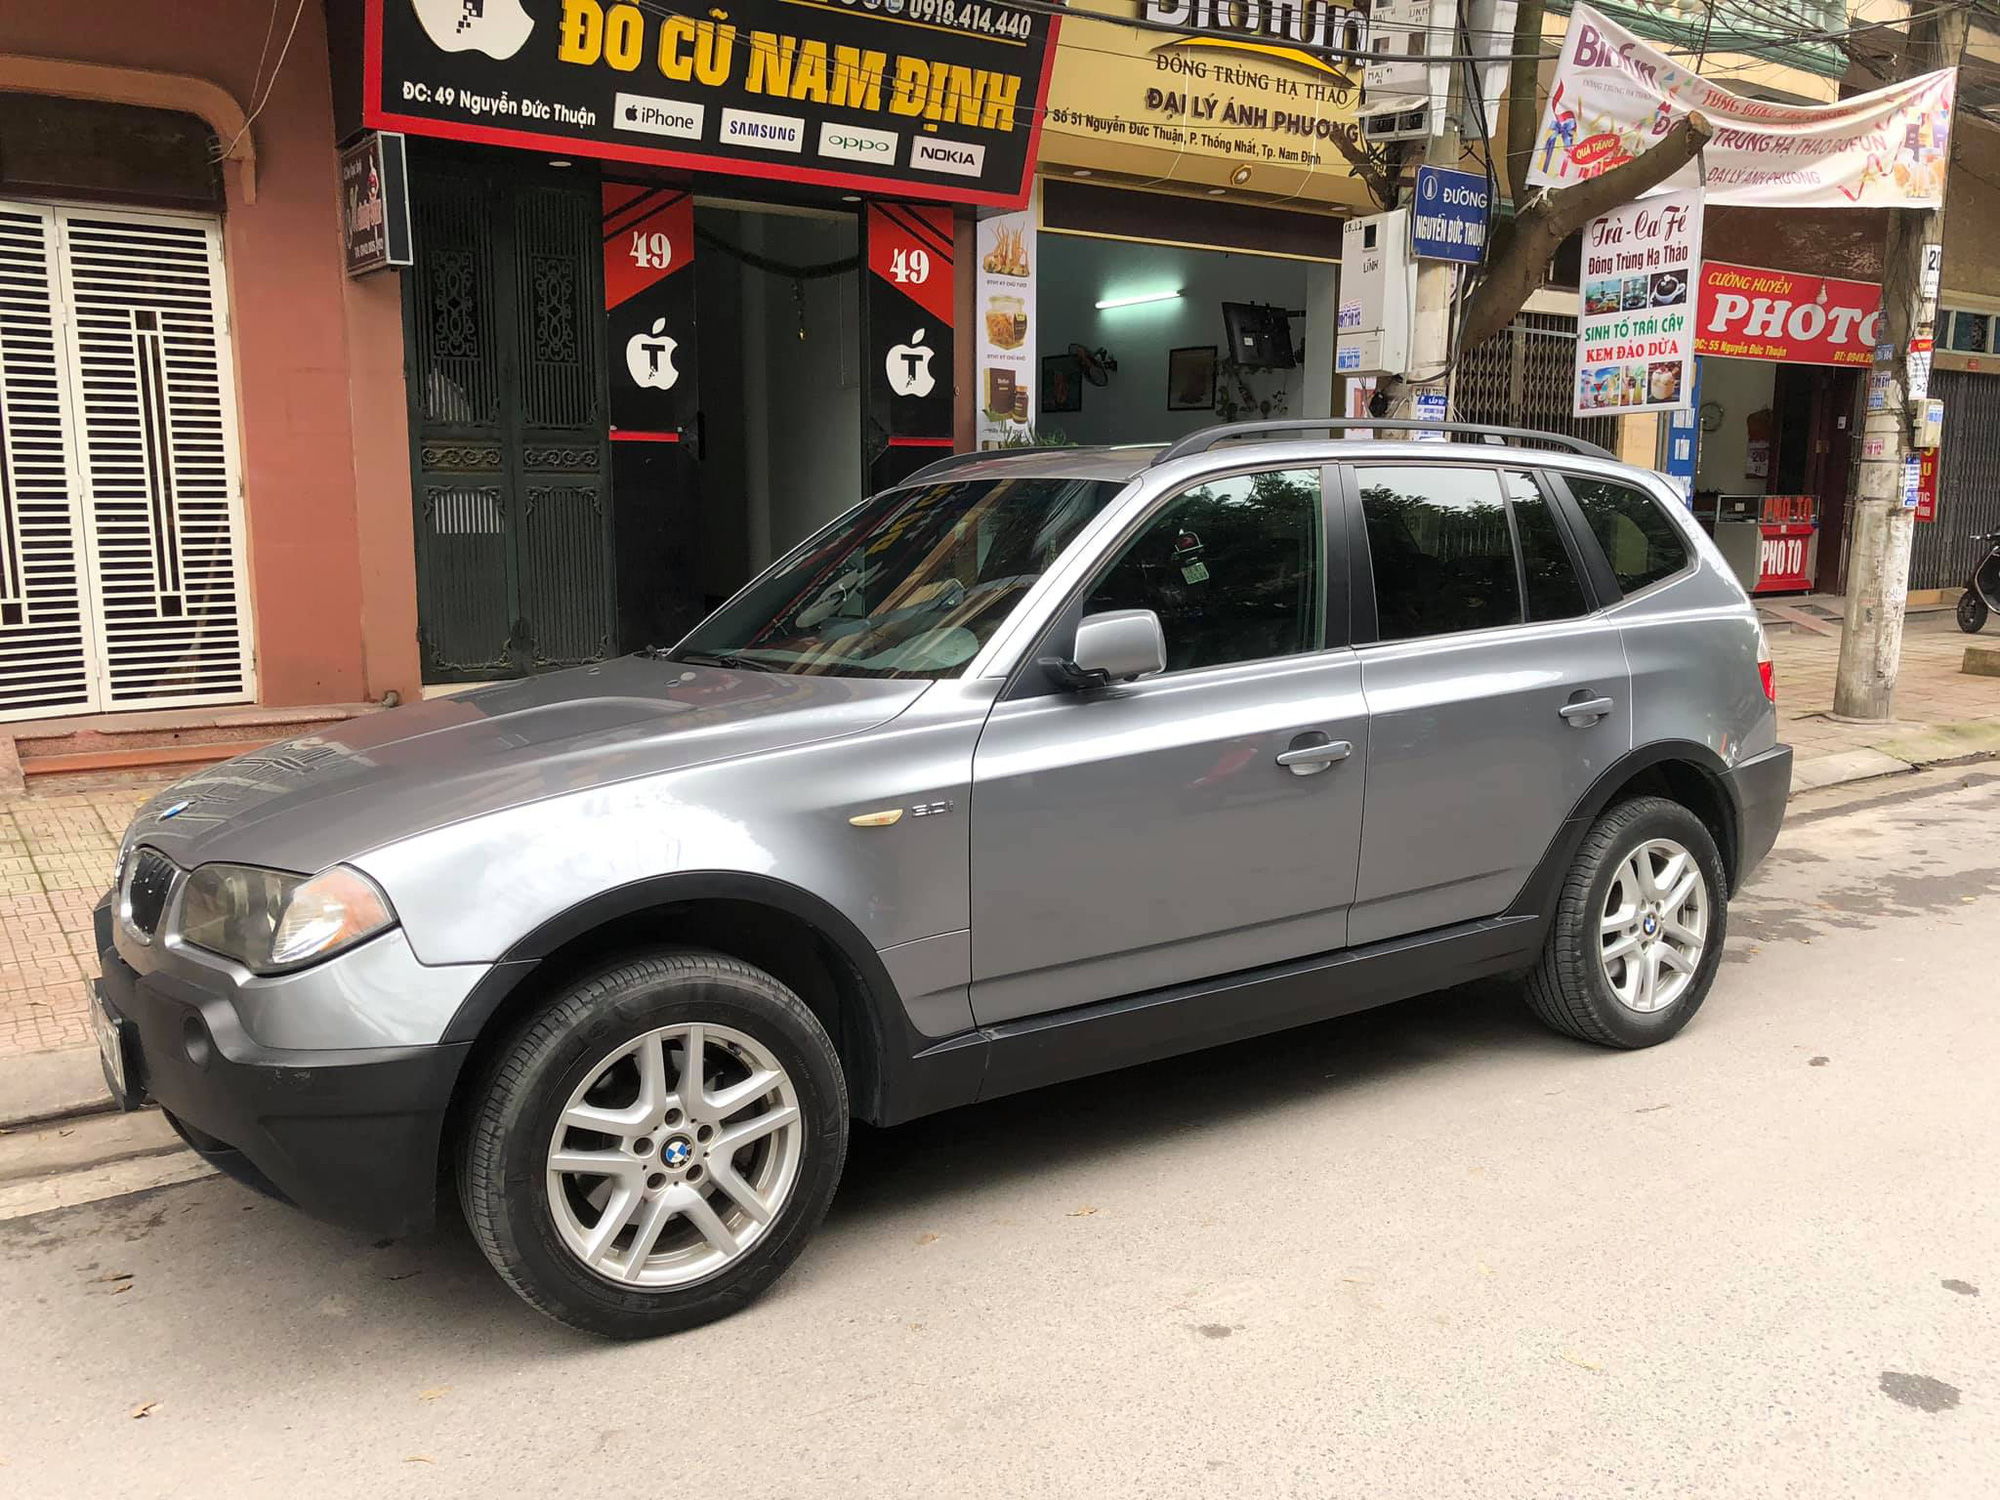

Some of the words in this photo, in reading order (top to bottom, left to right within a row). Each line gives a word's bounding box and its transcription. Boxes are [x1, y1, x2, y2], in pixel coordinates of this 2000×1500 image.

[909, 0, 1032, 39] 0918.414.440
[658, 7, 737, 87] CŨ
[745, 30, 887, 112] NAM
[889, 55, 1022, 132] ĐỊNH
[1156, 53, 1207, 79] ĐÔNG
[1213, 63, 1270, 91] TRÙNG
[1276, 78, 1299, 100] HẠ
[402, 80, 432, 103] ĐC:
[434, 86, 455, 106] 49
[459, 89, 518, 116] Nguyễn
[521, 98, 551, 120] Đức
[553, 103, 596, 129] Thuận
[641, 106, 694, 130] iPhone
[1145, 87, 1187, 120] ĐẠI
[1190, 92, 1219, 121] LÝ
[1221, 96, 1267, 129] ÁNH
[729, 119, 796, 142] SAMSUNG
[1052, 107, 1070, 124] Số
[1071, 111, 1082, 126] 51
[1085, 114, 1125, 134] Nguyễn
[1189, 133, 1198, 146] P.
[1201, 133, 1232, 154] Thống
[1262, 144, 1275, 160] Tp.
[1278, 147, 1299, 162] Nam
[1301, 151, 1322, 166] Định
[920, 146, 976, 166] NOKIA
[1443, 186, 1488, 209] ĐƯỜNG
[1415, 213, 1446, 242] NGUYỄN
[1447, 215, 1464, 244] ĐỨC
[628, 231, 672, 270] 49
[889, 247, 930, 285] 49
[1588, 256, 1613, 275] Đông
[1647, 247, 1660, 269] Hạ
[1663, 241, 1689, 264] Thảo
[1707, 271, 1752, 290] CƯỜNG
[1584, 325, 1610, 342] SINH
[1613, 316, 1631, 339] TỐ
[1633, 315, 1658, 338] TRÁI
[1661, 313, 1685, 333] CÂY
[1586, 346, 1614, 363] KEM
[1708, 340, 1720, 351] 55
